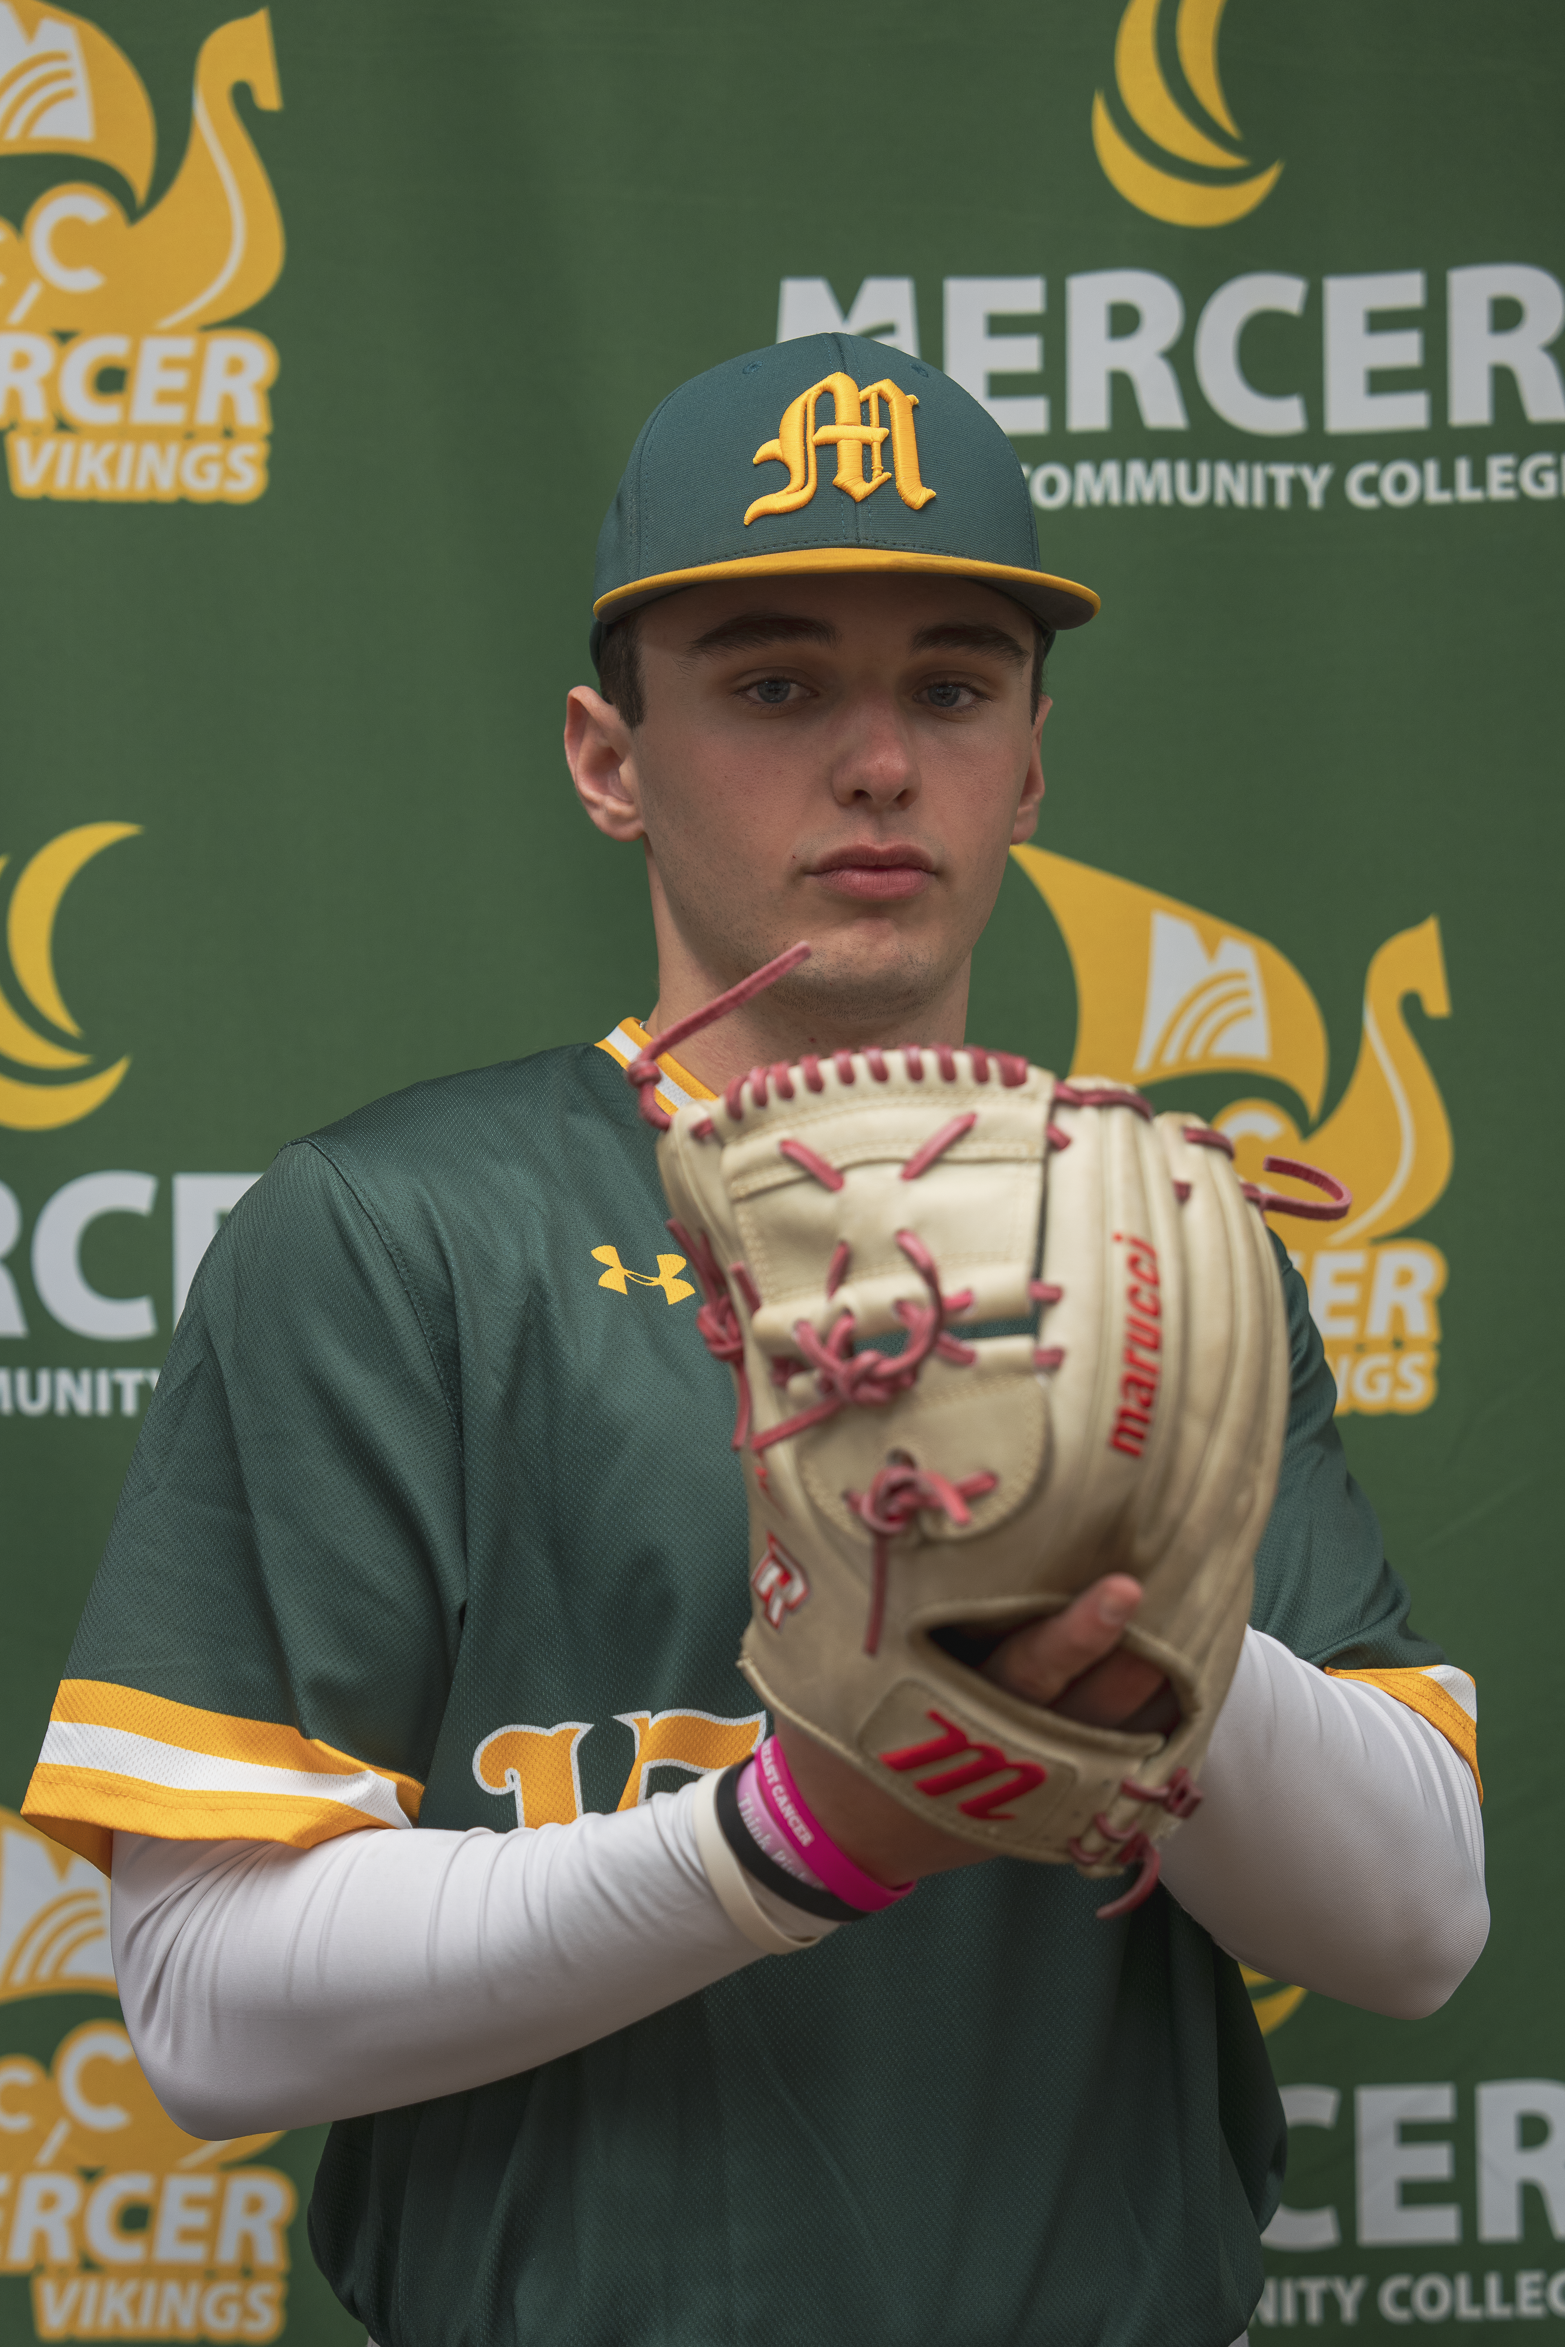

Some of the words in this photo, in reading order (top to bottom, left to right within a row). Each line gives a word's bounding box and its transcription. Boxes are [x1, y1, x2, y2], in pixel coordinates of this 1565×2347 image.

[14, 438, 258, 492] VIKINGS
[743, 371, 937, 526] M
[1021, 461, 1333, 511] OMMUNITY
[1344, 453, 1565, 510] COLLEG
[1288, 1249, 1436, 1339] ER
[1110, 1231, 1164, 1460] marucci
[0, 1367, 161, 1418] UNIT
[771, 1784, 815, 1847] CANCER
[0, 2173, 284, 2265] RCER
[41, 2278, 275, 2333] VIKINGS
